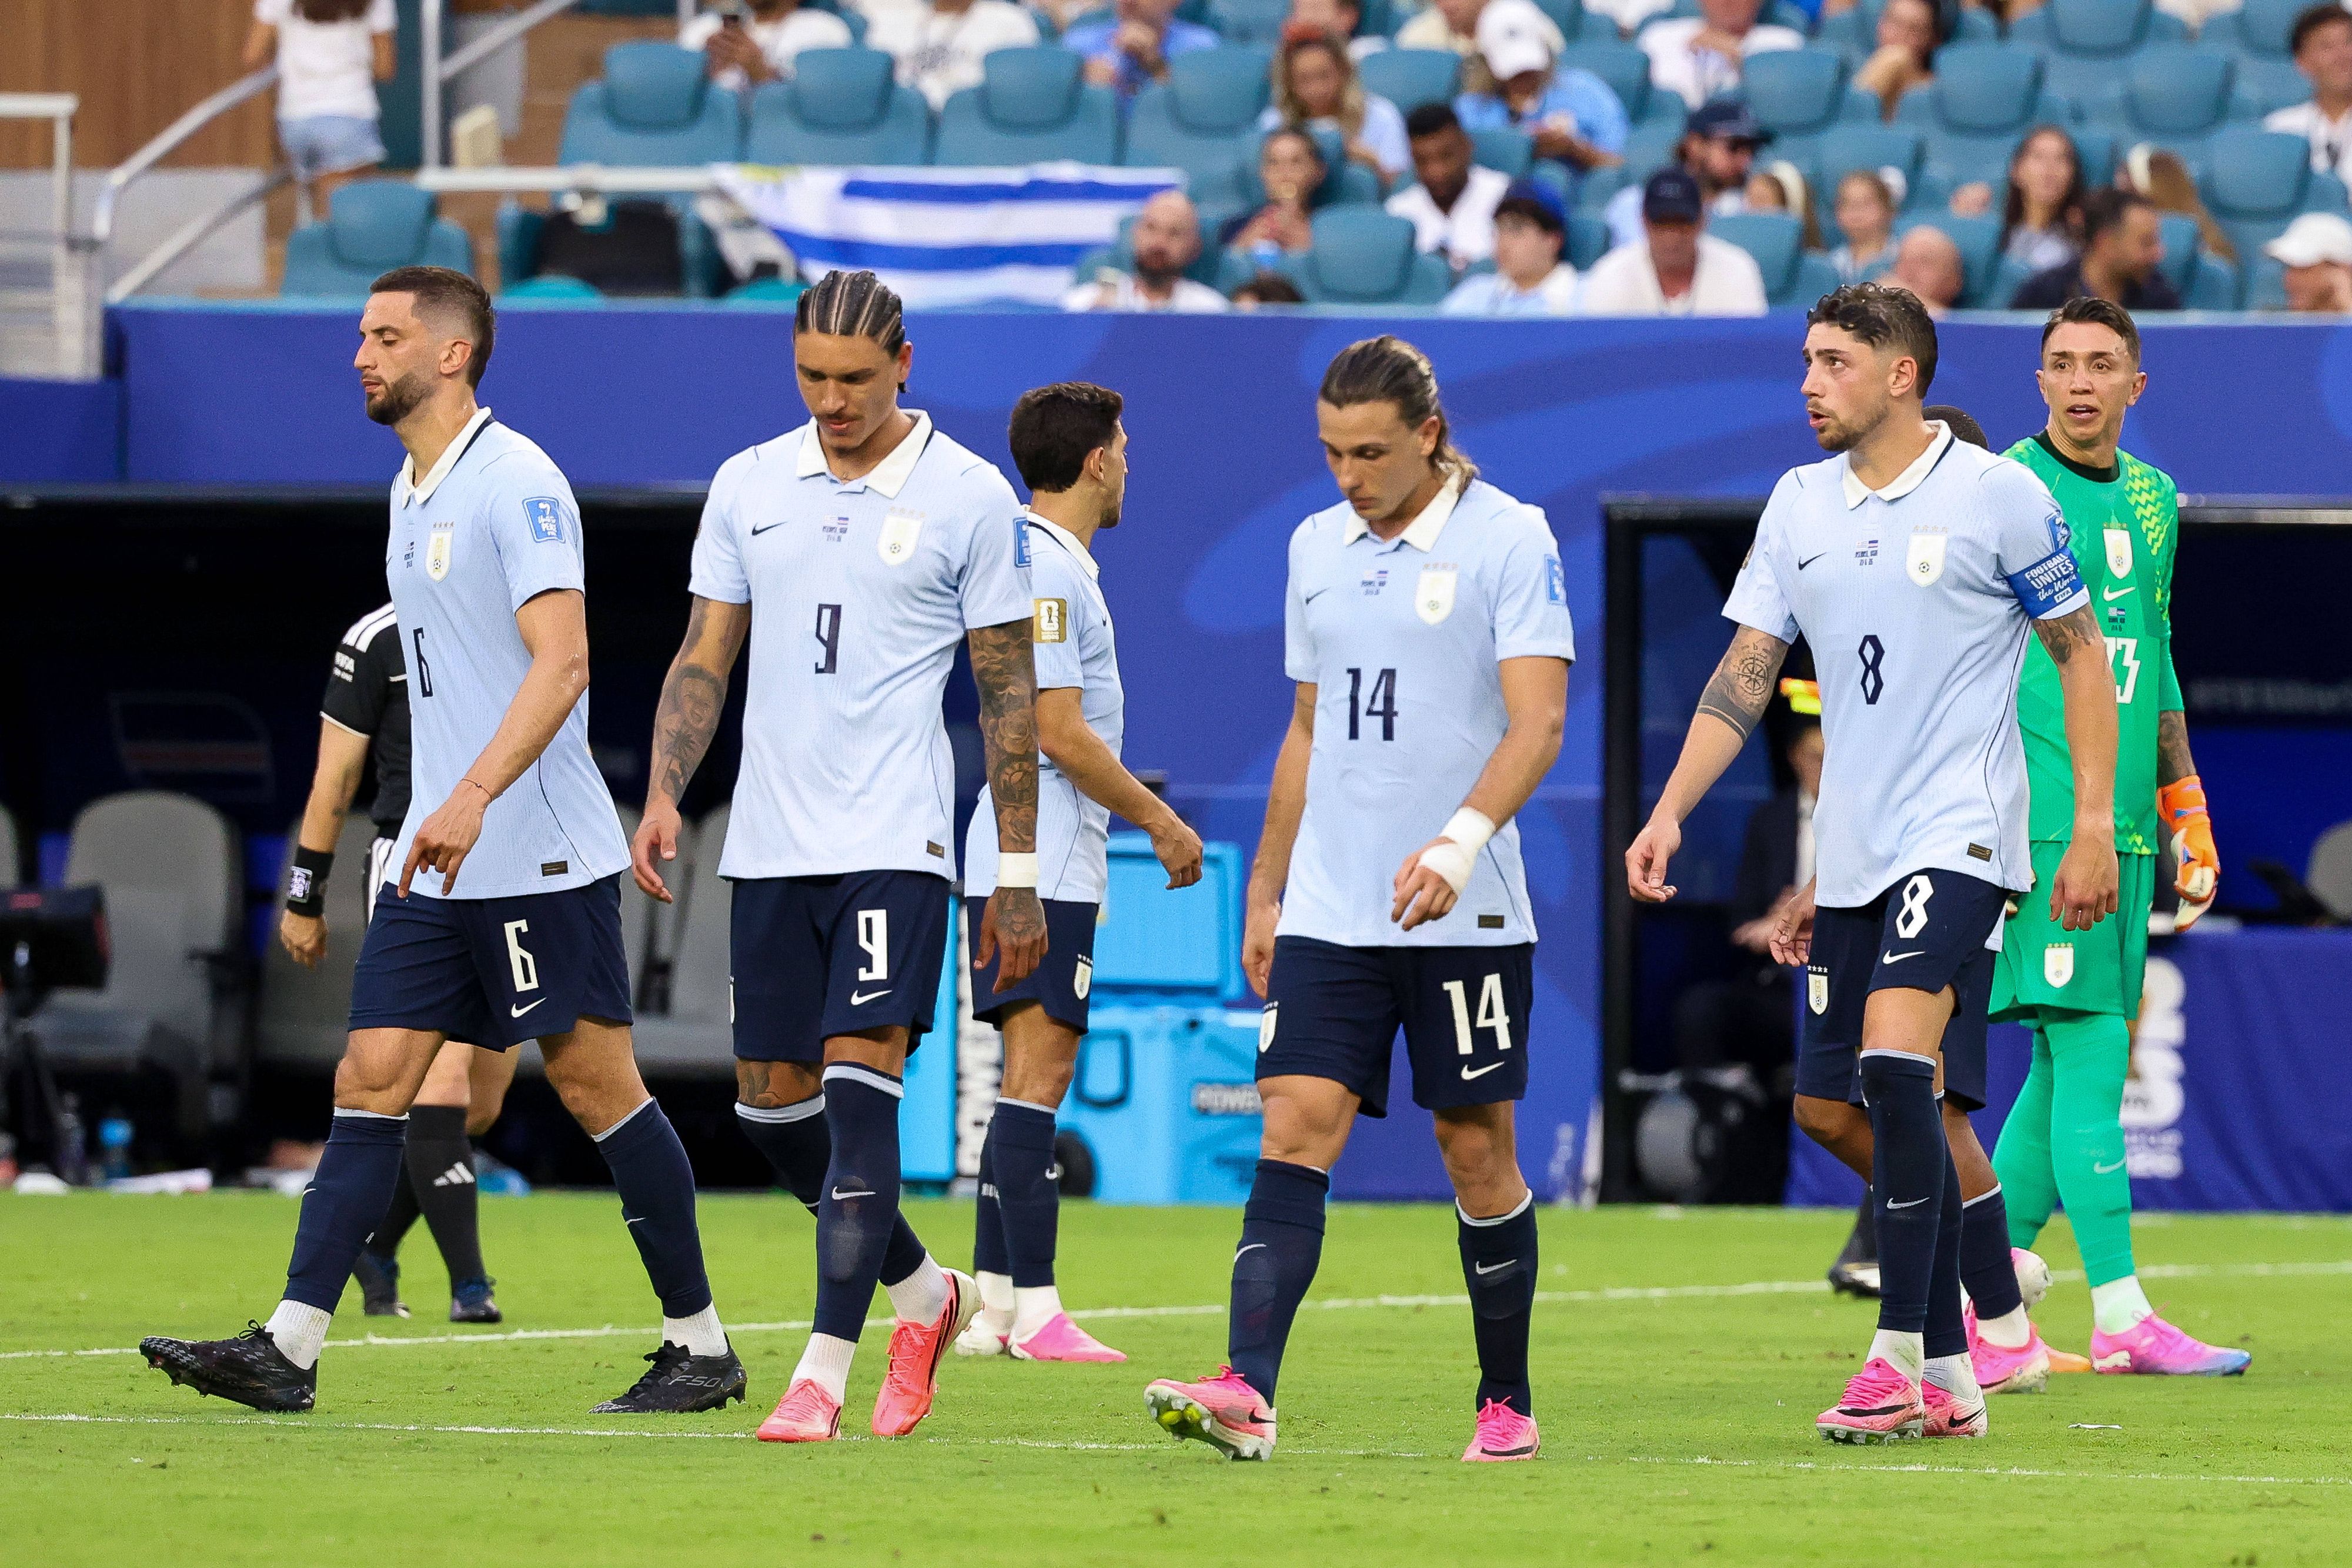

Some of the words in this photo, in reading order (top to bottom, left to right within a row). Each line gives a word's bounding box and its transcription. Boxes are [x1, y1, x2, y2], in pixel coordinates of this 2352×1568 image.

[2024, 553, 2069, 581] FOOTBALL
[2030, 559, 2074, 590] UNITES
[2036, 588, 2054, 601] the
[413, 627, 433, 698] 6
[814, 603, 842, 674] 9
[1857, 634, 1885, 705] 8
[1347, 667, 1399, 741] 14
[1896, 875, 1934, 939] 8
[504, 919, 539, 992] 6
[857, 909, 887, 981] 9
[1442, 973, 1512, 1055] 14
[668, 1375, 721, 1388] F50
